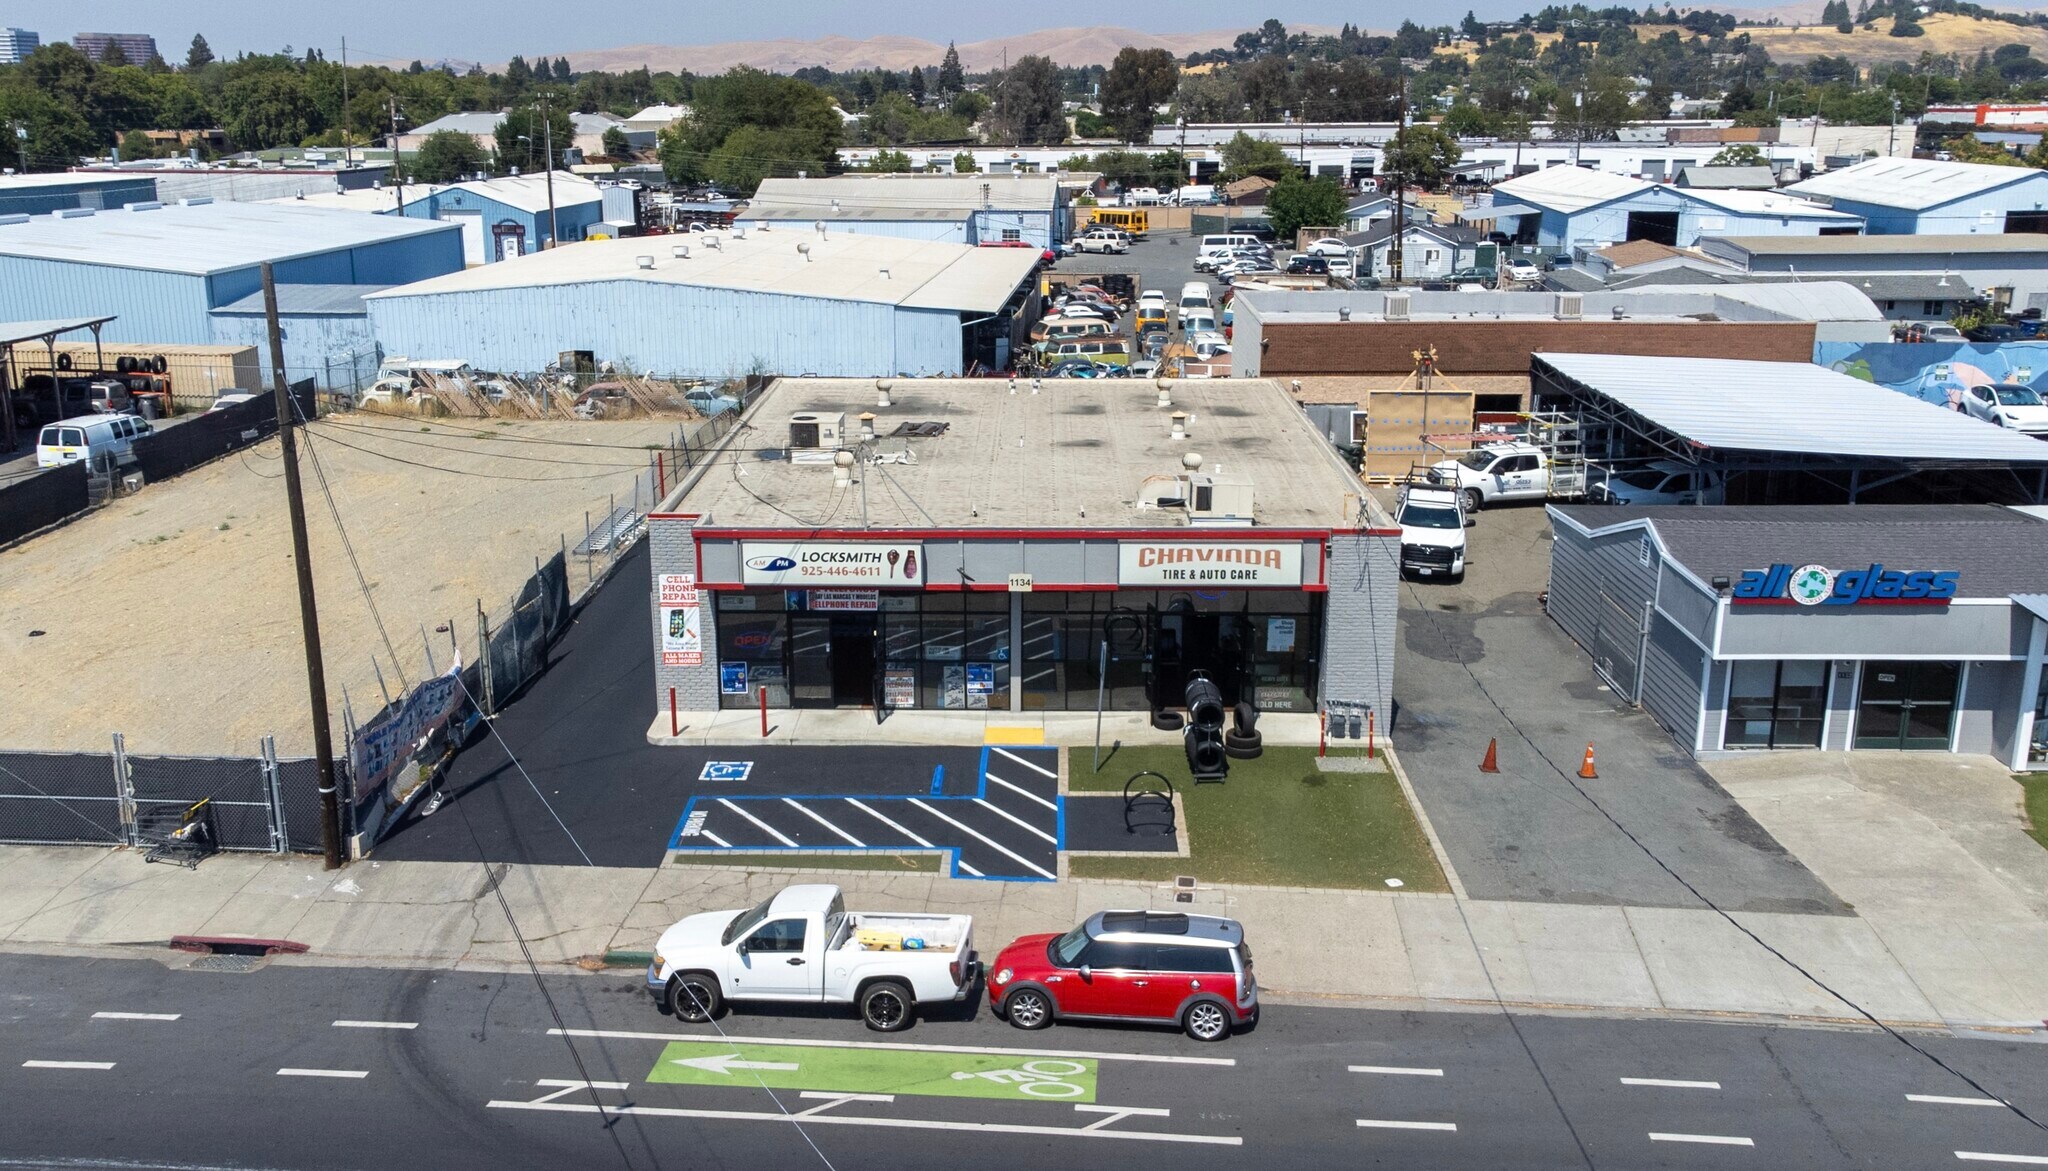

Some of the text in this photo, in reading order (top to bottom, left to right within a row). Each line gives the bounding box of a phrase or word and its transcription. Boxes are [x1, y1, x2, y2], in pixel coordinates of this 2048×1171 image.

[801, 552, 882, 563] LOCKSMITH
[1138, 547, 1281, 570] CHAVINDA
[801, 566, 881, 576] 925-446-4611
[1162, 569, 1258, 580] TIRE & AUTO CARE
[666, 575, 690, 584] CELL
[1010, 578, 1031, 587] 1134
[1733, 563, 1793, 598] all
[1826, 563, 1961, 604] glass
[662, 584, 696, 593] PHONE
[850, 600, 877, 609] REPAIR
[735, 635, 769, 646] OPEN
